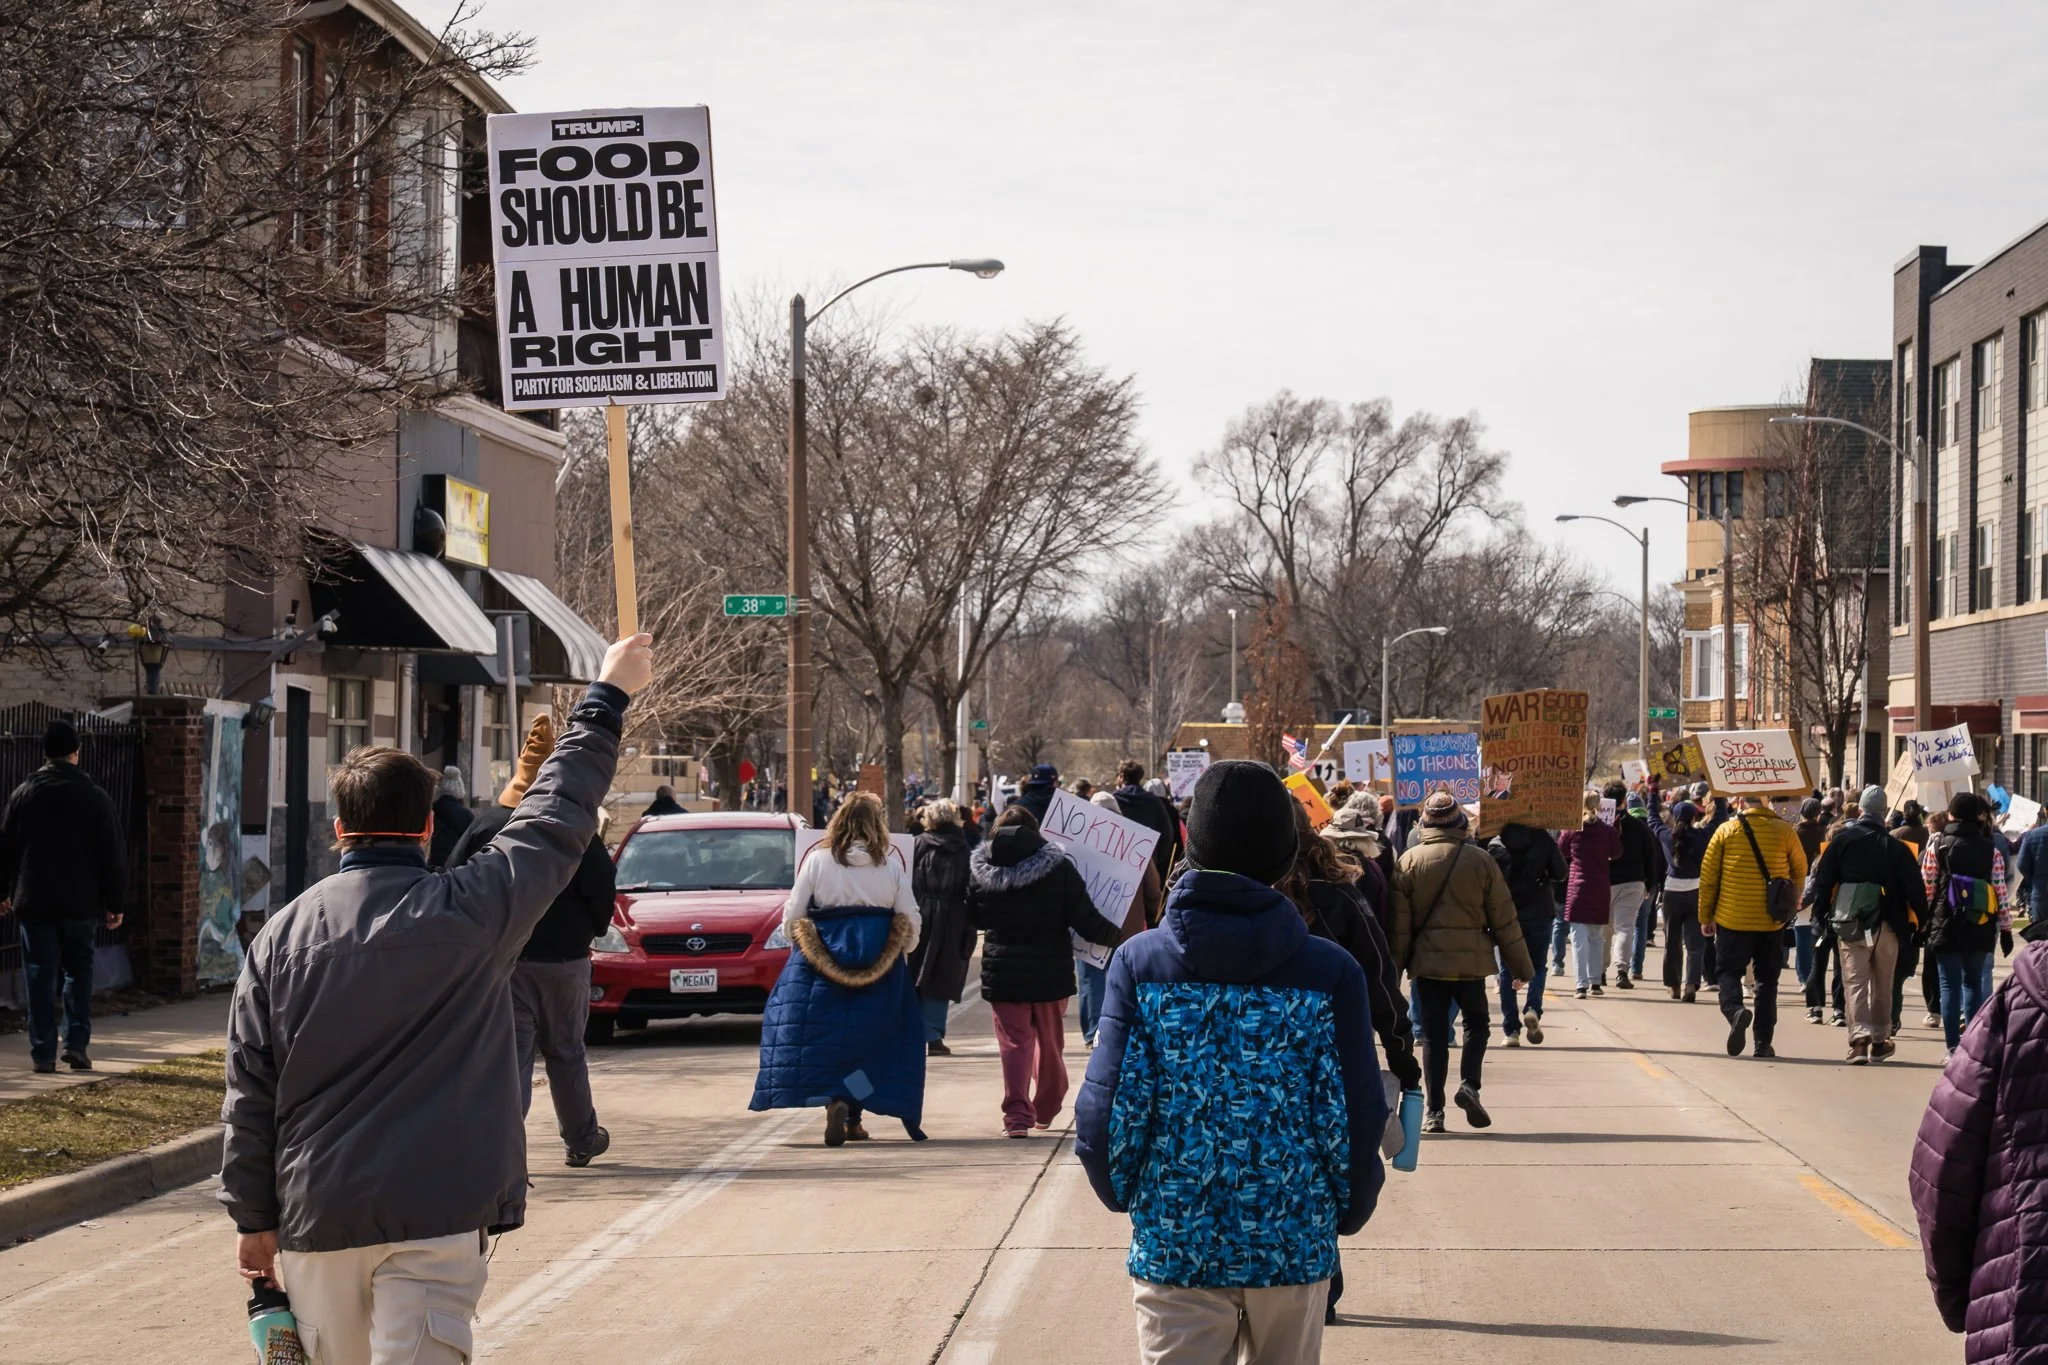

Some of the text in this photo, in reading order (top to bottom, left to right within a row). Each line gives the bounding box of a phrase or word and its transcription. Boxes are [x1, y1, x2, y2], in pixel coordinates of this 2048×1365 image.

[555, 119, 641, 136] TRUMP:
[499, 140, 700, 184] FOOD
[500, 179, 708, 247] SHOULD BE
[508, 261, 709, 333] A HUMAN
[510, 328, 712, 368] RIGHT
[515, 370, 713, 396] PARTY FOR SOCIALISM & LIBERATION
[1484, 691, 1588, 725] WAR GOOD
[1542, 707, 1586, 724] GOD
[1482, 726, 1508, 742] WHAT
[1561, 723, 1587, 739] FOR?
[1395, 735, 1478, 755] NO CROWNS
[1485, 737, 1582, 759] ABSOLUTELY
[1397, 753, 1479, 774] NO THRONES
[1491, 755, 1578, 775] NOTHING!
[1396, 779, 1420, 799] NO
[1045, 797, 1086, 836] NO
[682, 974, 715, 987] MEGAN7
